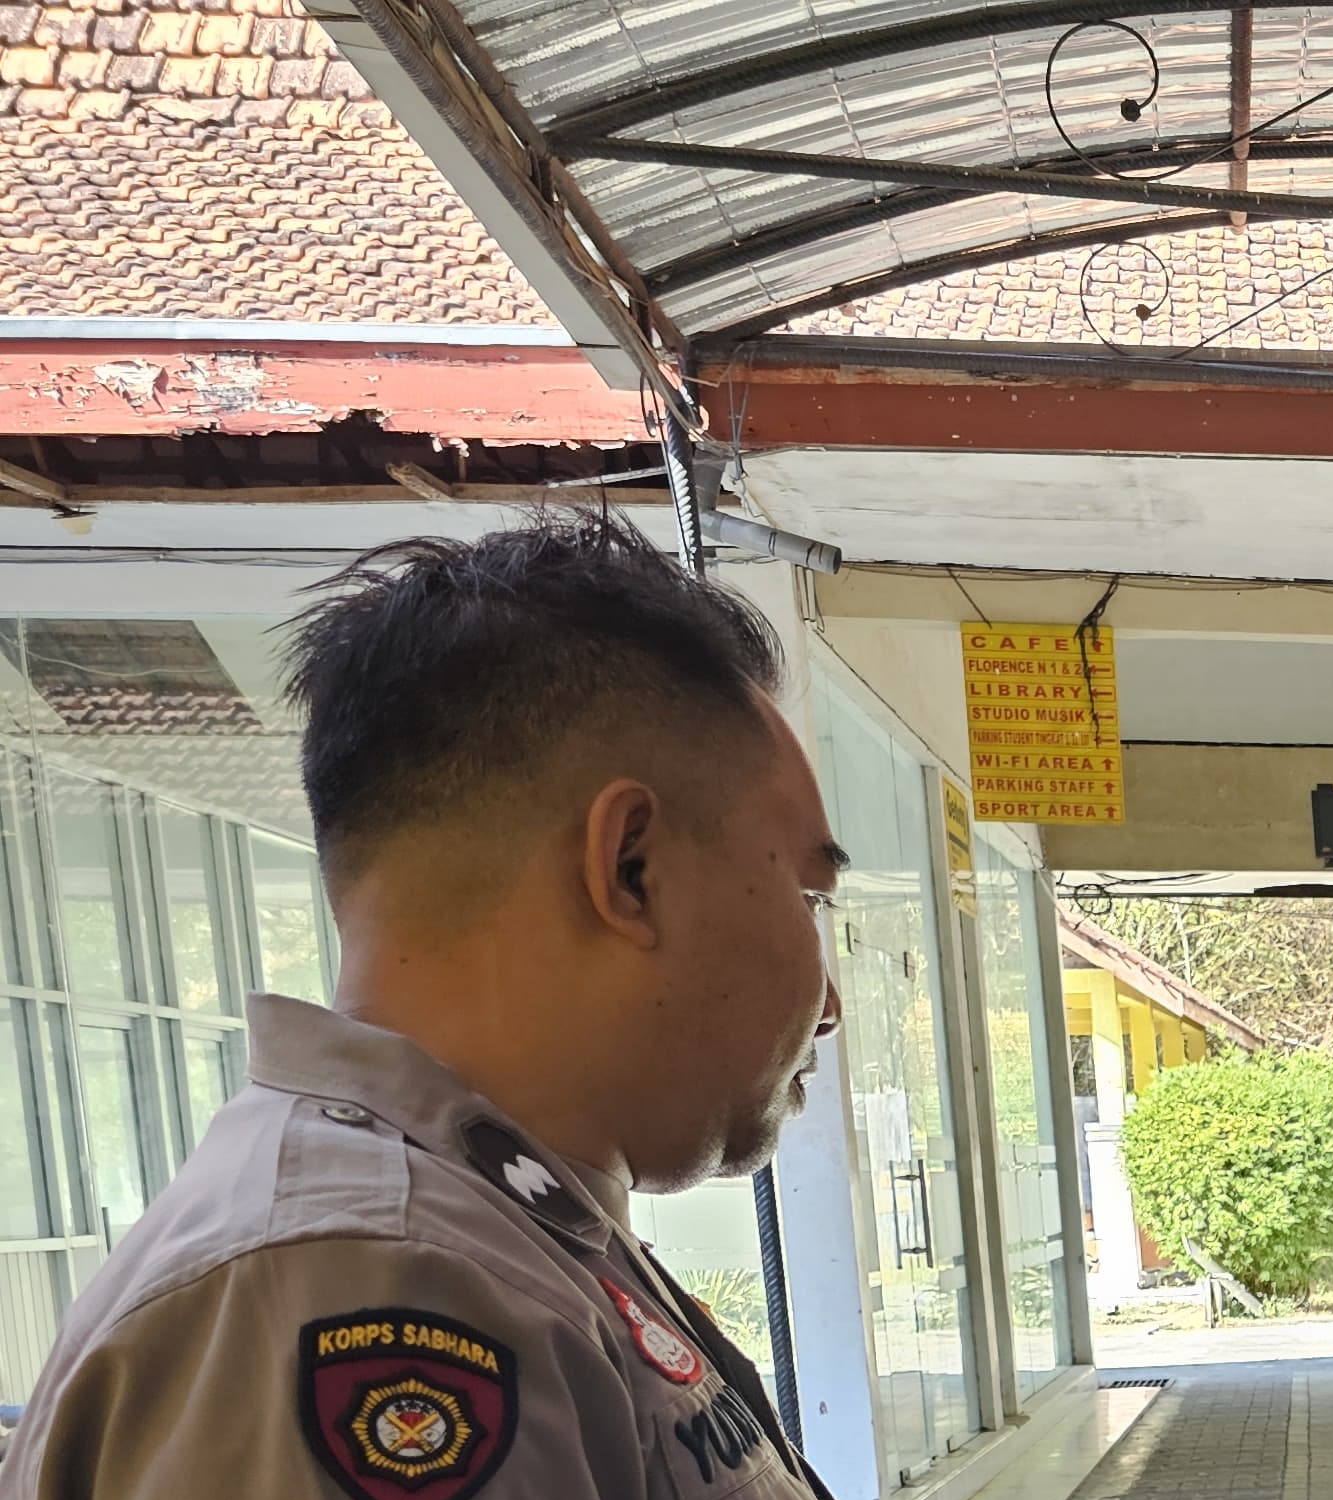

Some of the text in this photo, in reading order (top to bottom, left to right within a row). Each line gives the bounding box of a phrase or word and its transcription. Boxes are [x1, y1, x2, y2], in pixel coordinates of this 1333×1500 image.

[970, 636, 1069, 651] CAFE
[968, 659, 1082, 675] FLORENCE N 1 & 2
[970, 683, 1082, 699] LIBRARY
[972, 707, 1085, 723] STUDIO MUSIK
[976, 754, 1093, 770] WI-FI AREA
[977, 778, 1096, 794] PARKING STAFF
[979, 803, 1097, 818] SPORT AREA
[318, 1322, 500, 1374] KORPS SABHARA
